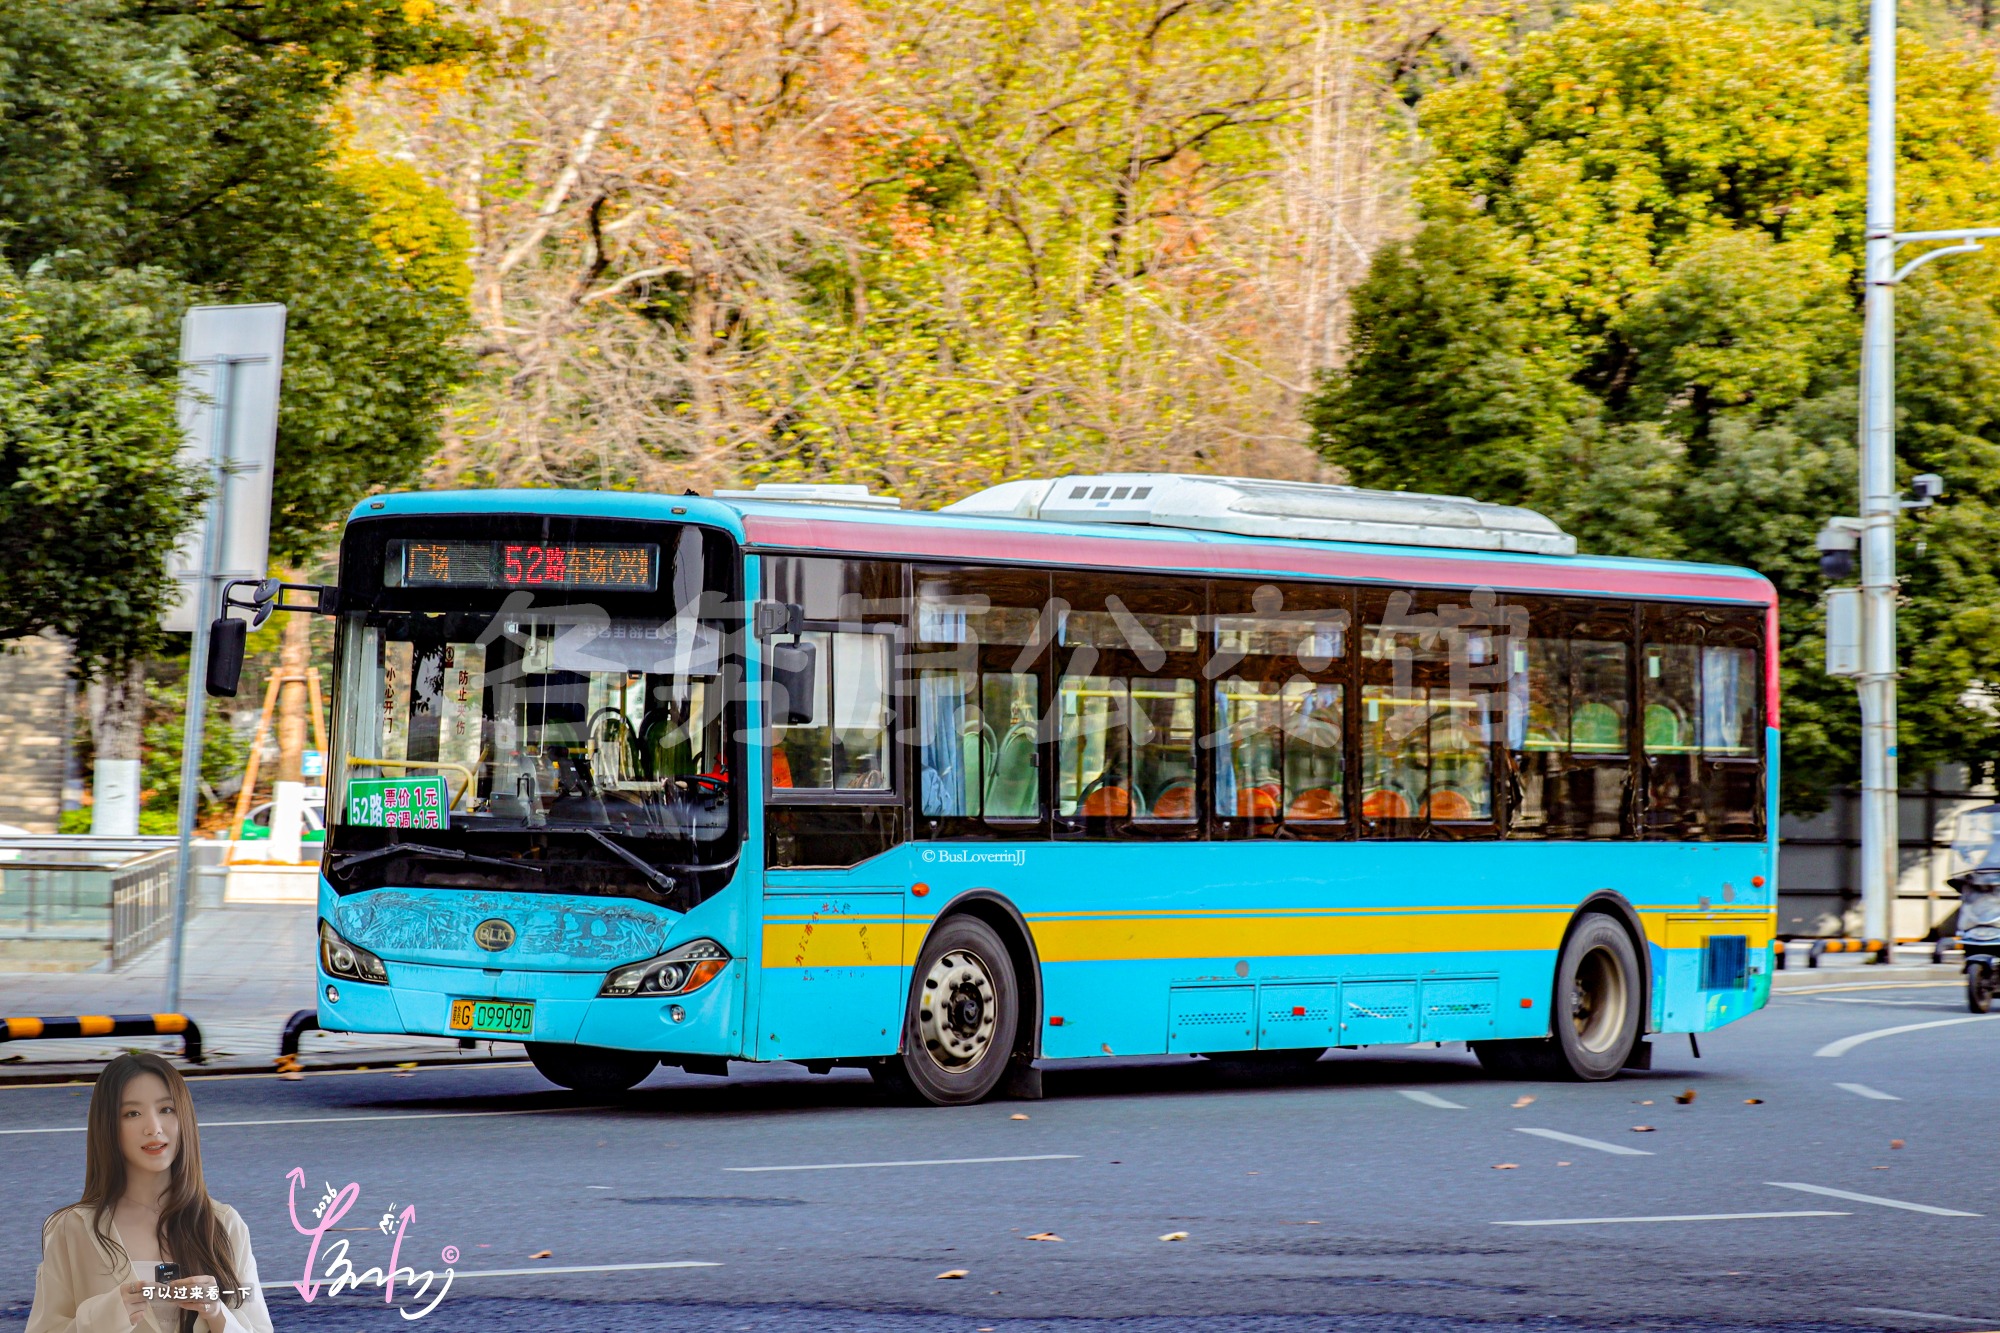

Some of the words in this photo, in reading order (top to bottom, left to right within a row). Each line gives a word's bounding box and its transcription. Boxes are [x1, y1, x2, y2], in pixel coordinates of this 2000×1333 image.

[408, 545, 448, 580] 广场
[384, 667, 396, 733] 小心开门
[456, 670, 469, 735] 防止夹伤
[352, 793, 383, 827] 52路
[384, 786, 438, 808] 票价1元
